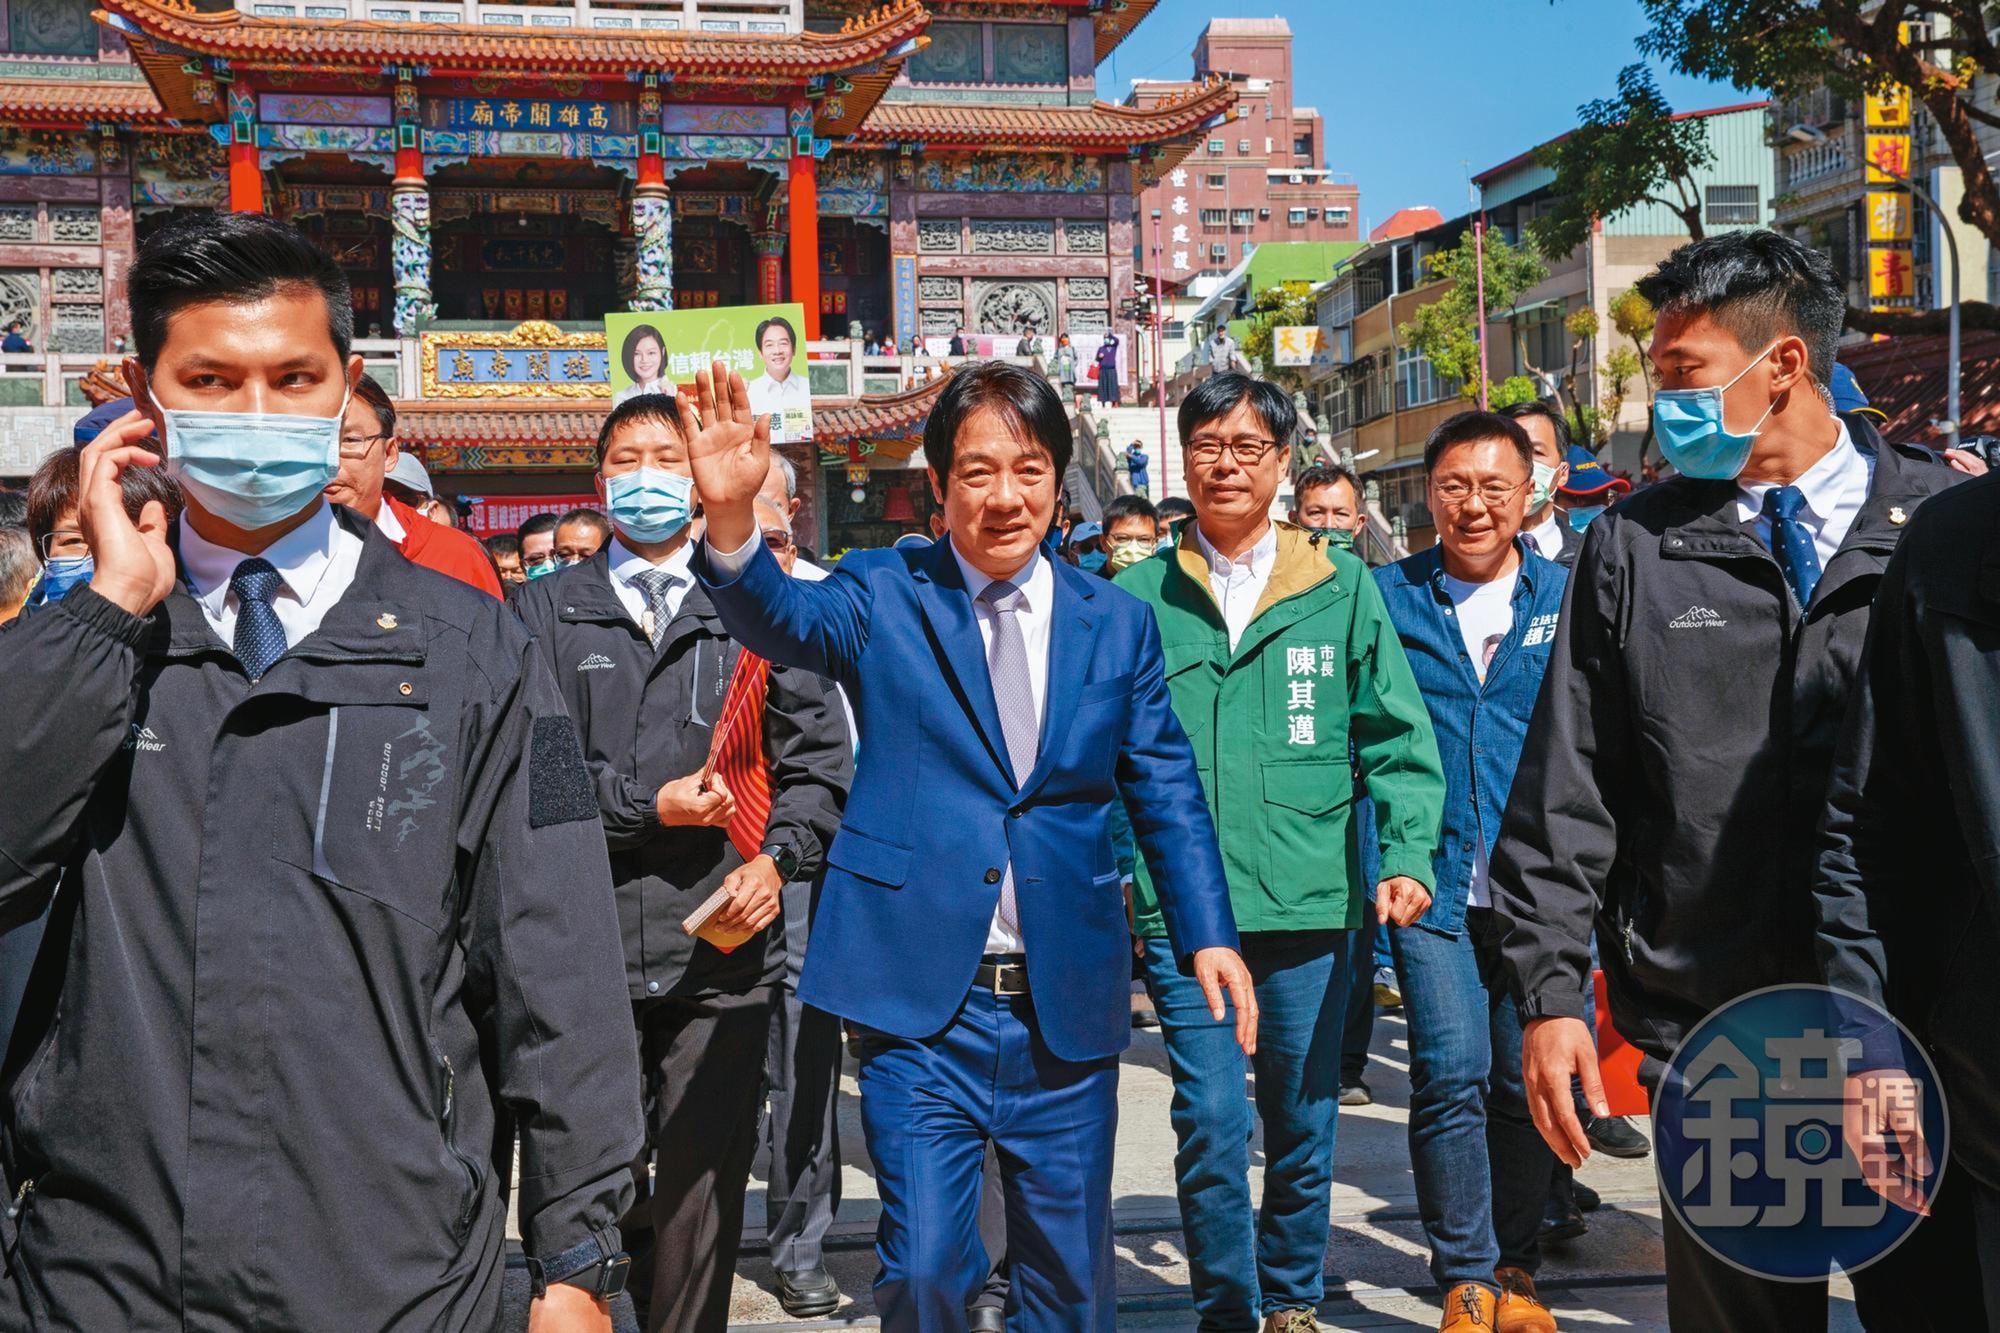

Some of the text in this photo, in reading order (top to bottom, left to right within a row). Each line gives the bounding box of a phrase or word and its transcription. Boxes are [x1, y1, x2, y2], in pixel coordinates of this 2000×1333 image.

[670, 348, 754, 375] 信賴台灣
[1669, 618, 1727, 628] Outdoor Wear
[1320, 644, 1335, 677] 市長
[1286, 646, 1318, 745] 陳其邁
[136, 739, 166, 752] Wear
